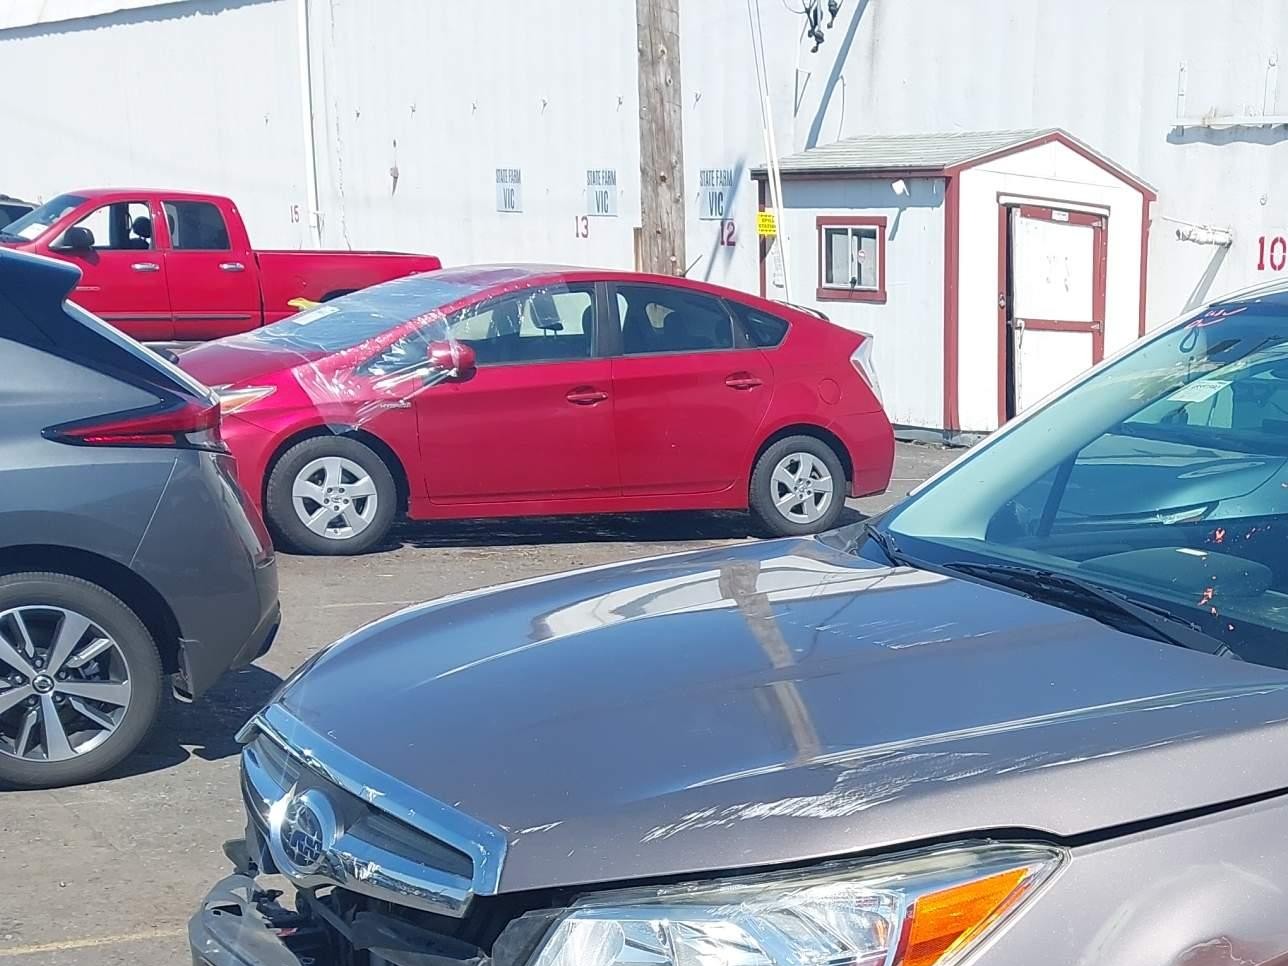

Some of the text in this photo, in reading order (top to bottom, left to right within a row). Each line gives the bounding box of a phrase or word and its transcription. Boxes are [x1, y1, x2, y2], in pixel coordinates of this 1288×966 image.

[496, 169, 521, 184] STATE FARM
[587, 170, 617, 186] STATE FARM
[699, 170, 733, 186] STATE FARM
[503, 188, 515, 209] VIC
[595, 190, 609, 213] VIC
[708, 191, 724, 216] VIC
[290, 204, 300, 224] 15
[575, 216, 589, 238] 13
[720, 220, 736, 246] 12
[1257, 236, 1287, 271] 10
